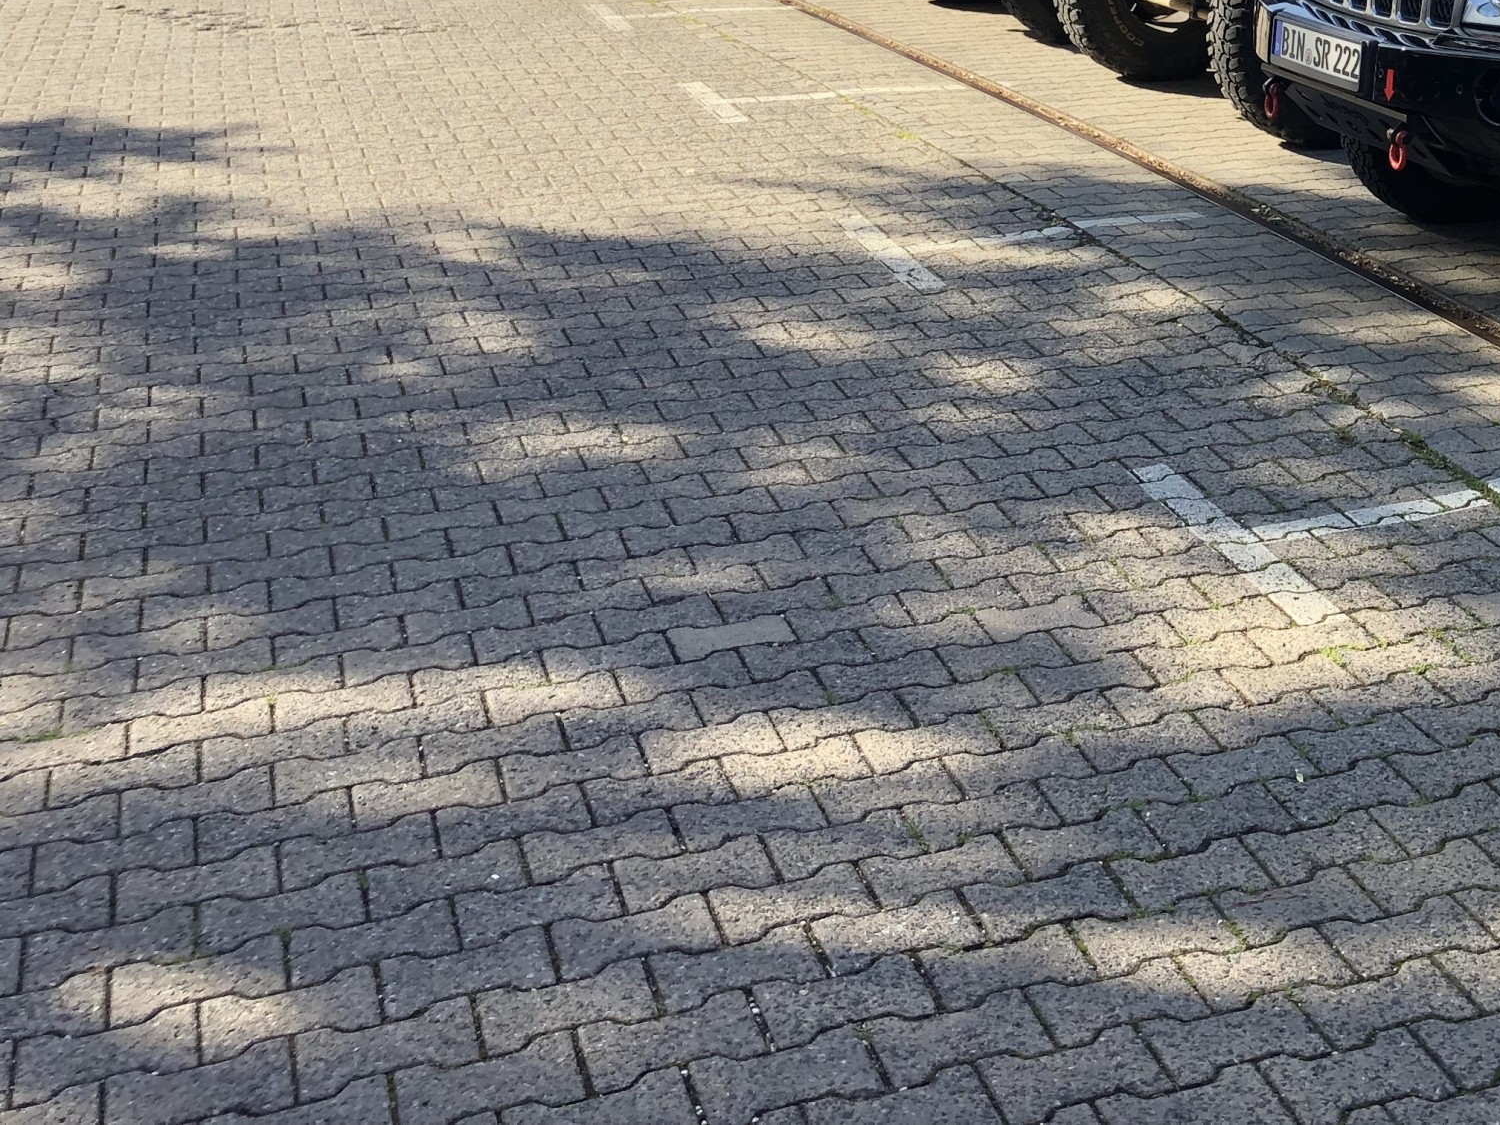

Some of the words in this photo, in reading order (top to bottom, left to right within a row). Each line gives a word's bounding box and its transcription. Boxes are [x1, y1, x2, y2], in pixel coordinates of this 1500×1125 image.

[1281, 24, 1306, 61] BIN
[1313, 36, 1331, 71] SR
[1335, 43, 1362, 79] 222
